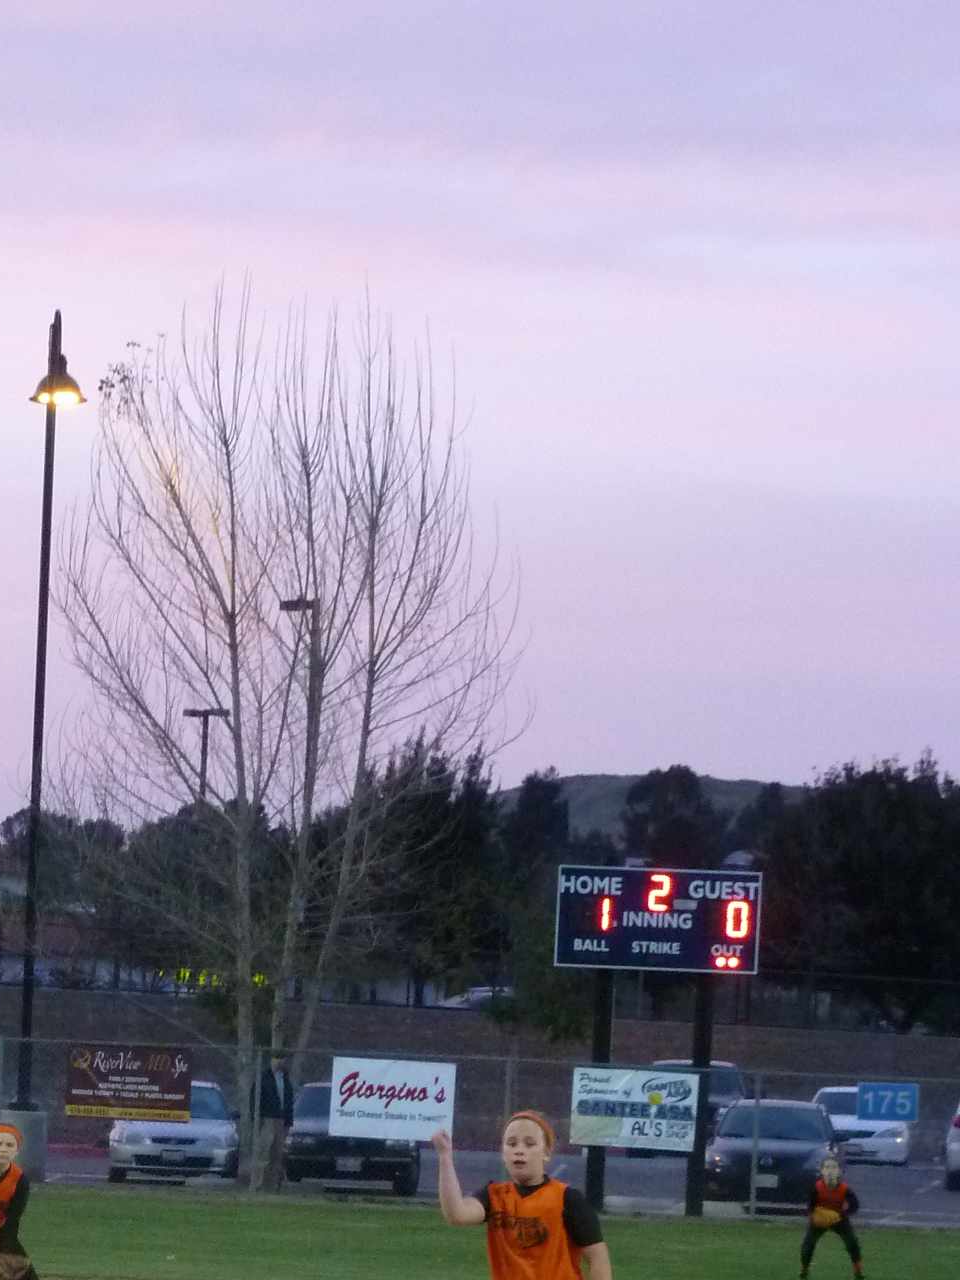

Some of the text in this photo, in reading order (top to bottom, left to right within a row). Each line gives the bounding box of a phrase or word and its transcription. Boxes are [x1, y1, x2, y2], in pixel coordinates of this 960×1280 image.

[560, 875, 758, 900] HOME GUEST
[646, 873, 672, 913] 2
[599, 898, 611, 932] 1
[622, 911, 693, 930] INNING
[725, 900, 750, 939] 0
[573, 938, 744, 957] BALL STRIKE OUT
[339, 1071, 447, 1109] Giorgino's
[863, 1090, 913, 1115] 175
[576, 1099, 651, 1119] SANTEE
[631, 1121, 663, 1137] AL'S
